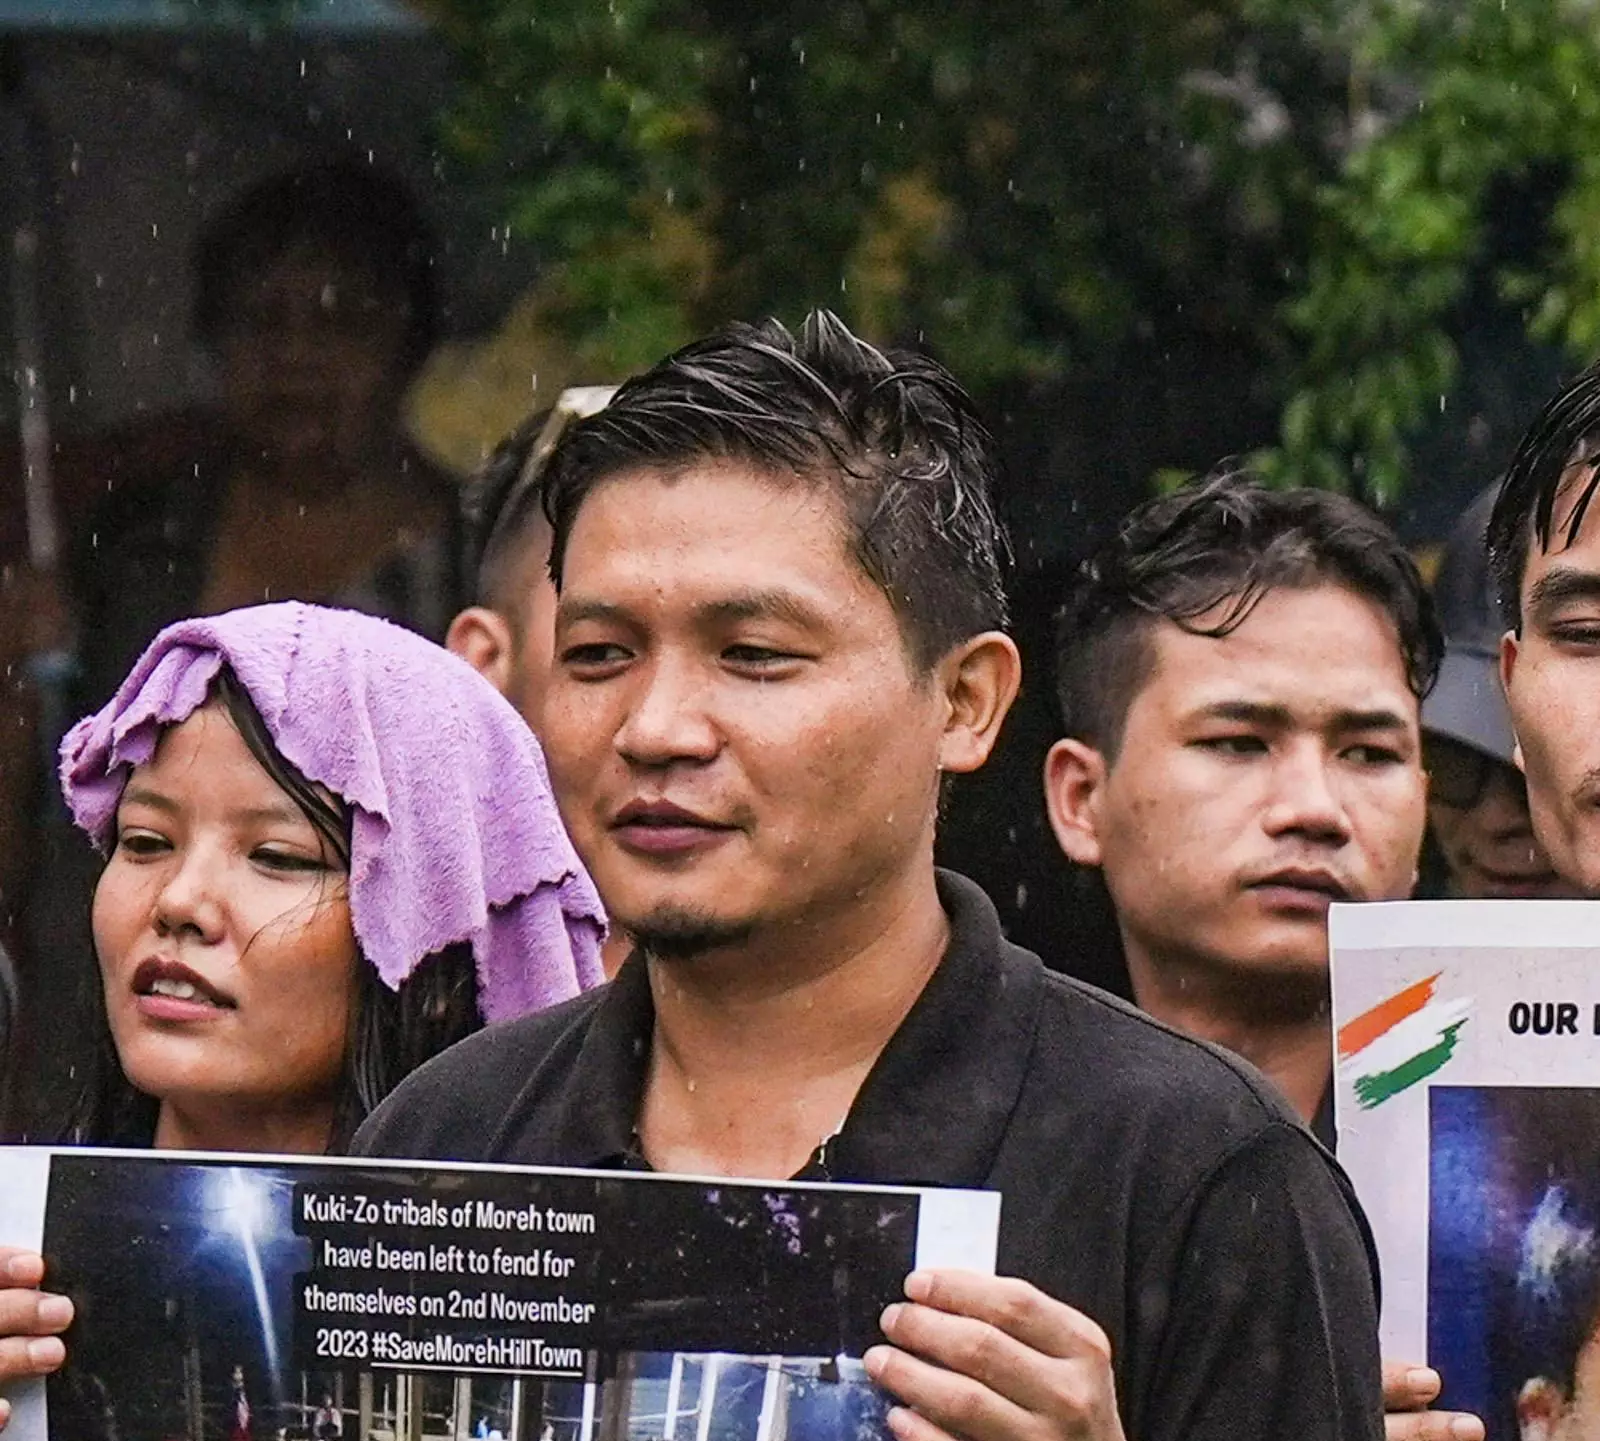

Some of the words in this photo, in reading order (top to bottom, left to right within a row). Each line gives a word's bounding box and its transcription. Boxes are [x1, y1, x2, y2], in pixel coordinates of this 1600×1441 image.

[1509, 1001, 1579, 1036] OUR
[303, 1194, 379, 1224] Kuki-Zo
[383, 1199, 448, 1227] tribals
[451, 1202, 472, 1227] of
[476, 1201, 542, 1231] Moreh
[547, 1207, 595, 1233] town
[324, 1240, 372, 1268] have
[376, 1242, 427, 1271] been
[429, 1244, 464, 1273] left
[468, 1250, 489, 1274] to
[493, 1247, 539, 1276] fend
[542, 1250, 575, 1277] for
[304, 1285, 416, 1316] themselves
[420, 1296, 444, 1317] on
[449, 1290, 486, 1318] 2nd
[491, 1293, 596, 1323] November
[316, 1329, 368, 1358] 2023
[372, 1332, 583, 1368] #SaveMorehHillTown
